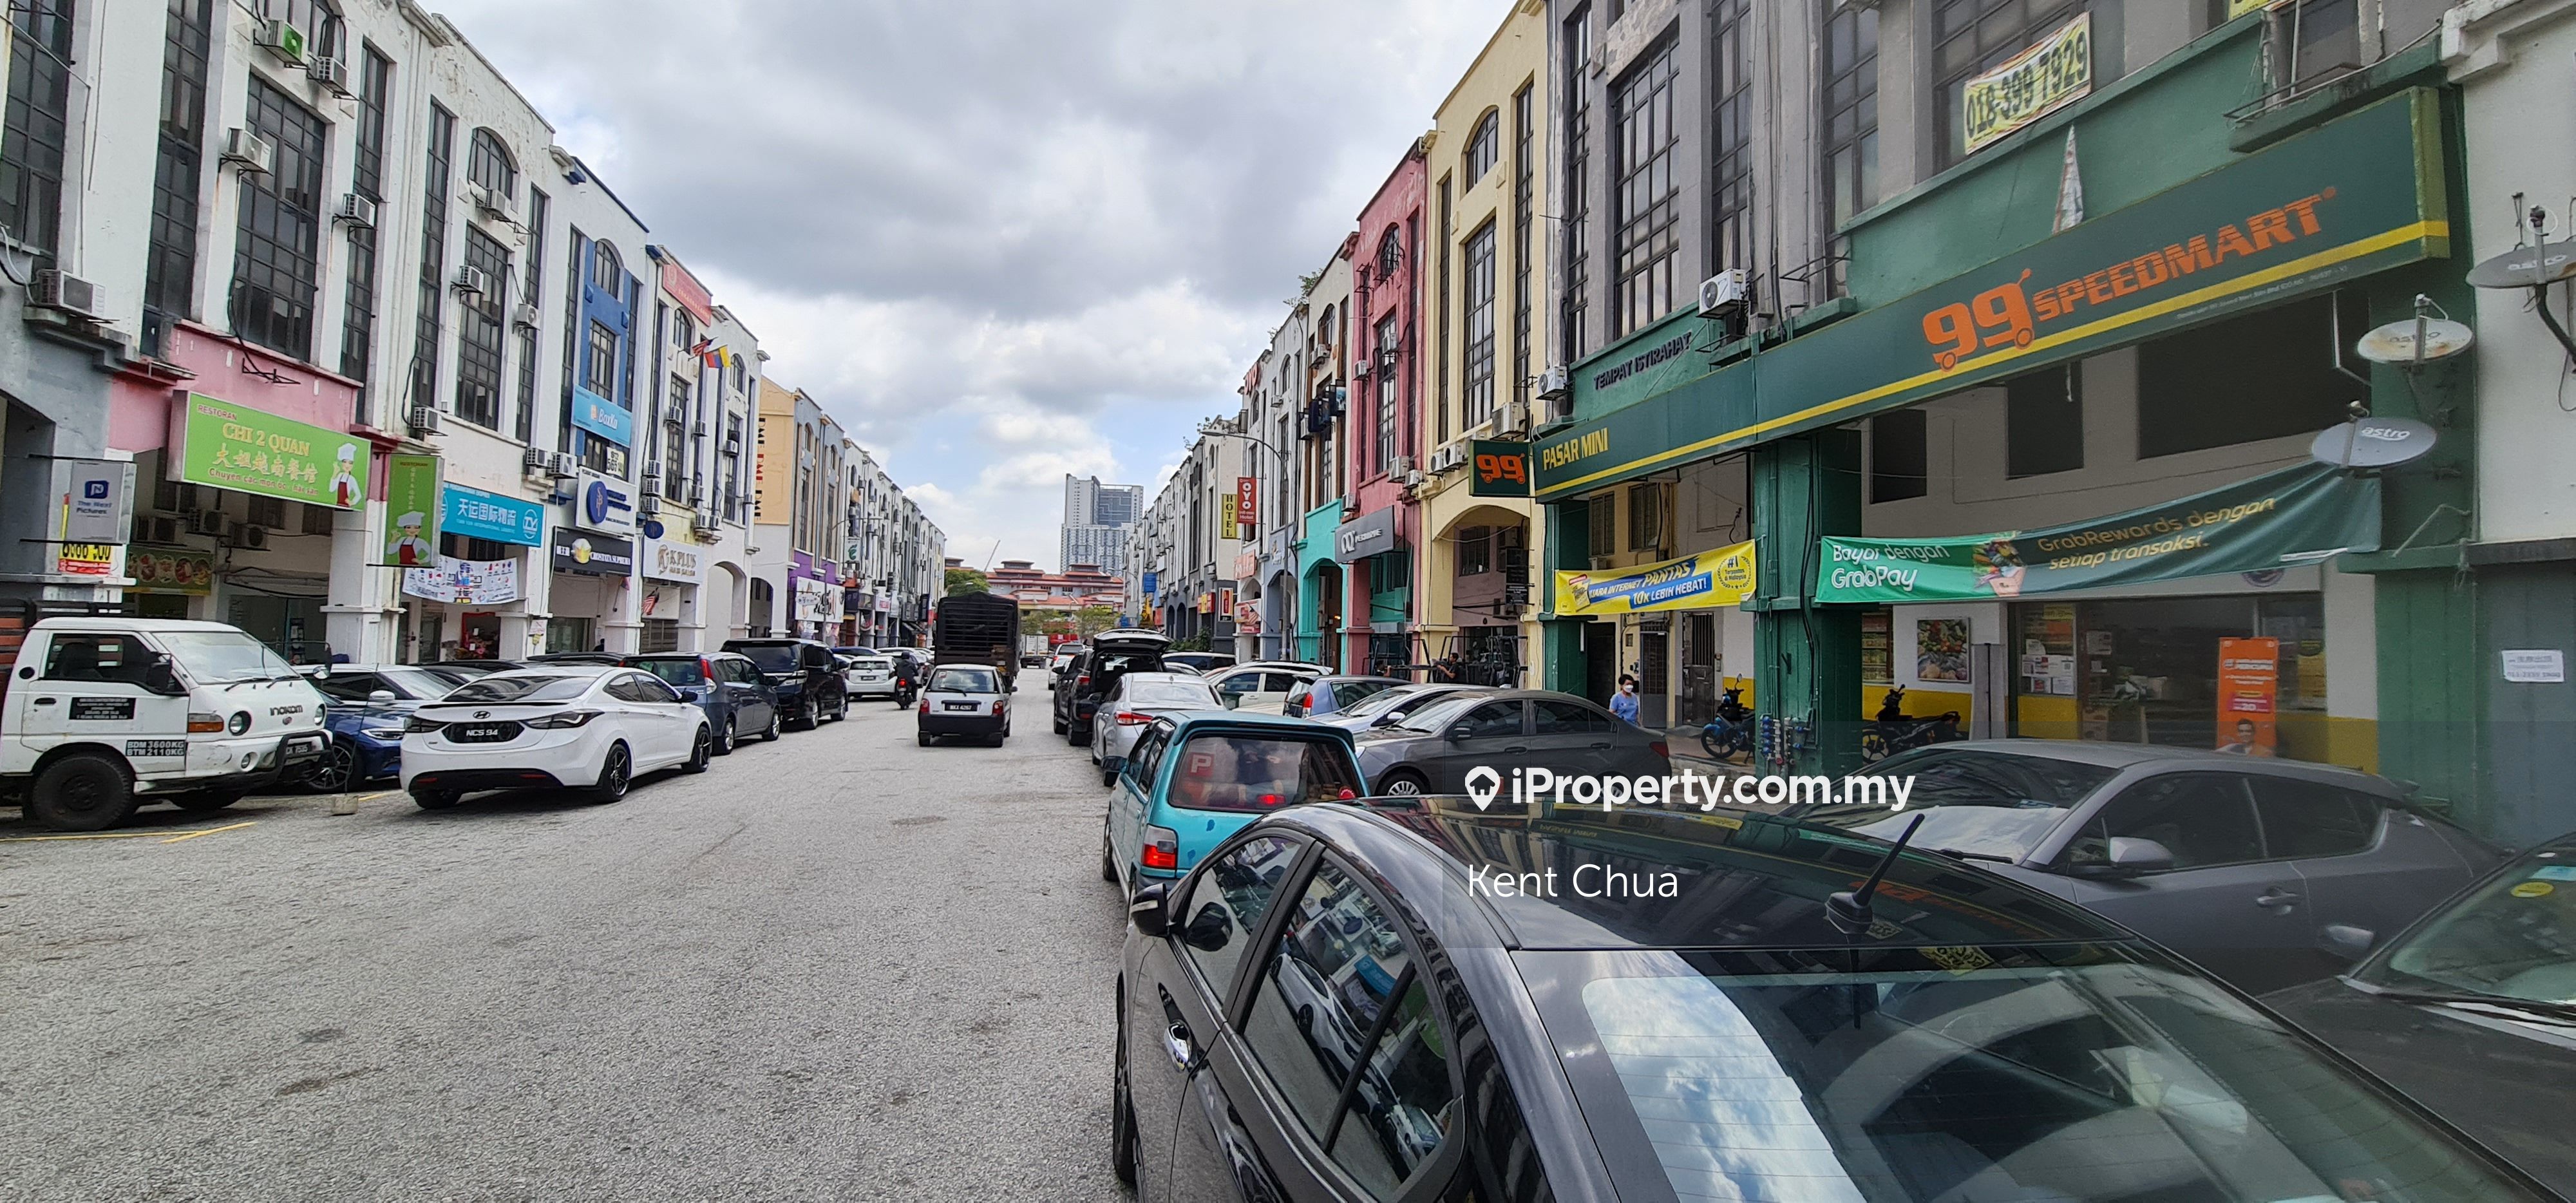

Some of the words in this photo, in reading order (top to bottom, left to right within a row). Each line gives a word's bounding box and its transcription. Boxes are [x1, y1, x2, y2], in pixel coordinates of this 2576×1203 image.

[1967, 63, 2034, 138] 018-399
[2039, 31, 2088, 100] 7929
[1922, 268, 2034, 372] 99
[2032, 193, 2322, 321] SPEEDMART
[1594, 359, 1633, 390] TEMPAT
[1634, 331, 1691, 374] ISTIRAHAT
[198, 404, 238, 421] RESTORAN
[222, 422, 253, 444] CHI
[256, 430, 265, 447] 2
[268, 433, 310, 456] QUAN
[2362, 425, 2410, 440] astro
[1542, 438, 1580, 471] PASAR
[1580, 427, 1609, 459] MINI
[1476, 453, 1526, 484] 99
[1242, 482, 1252, 510] OYO
[457, 498, 516, 527] 天运国际物流
[2038, 517, 2183, 552] GrabRewards
[2188, 498, 2275, 527] dengan
[1833, 545, 1879, 565] Bayar
[1884, 544, 1950, 562] dengan
[2049, 550, 2105, 570] setiap
[2110, 531, 2210, 562] transaksi.
[1607, 579, 1643, 594] INTERNET
[1642, 562, 1690, 587] PANTAS
[1651, 585, 1674, 601] LEBIH
[1675, 578, 1707, 595] HEBAT!
[1831, 565, 1918, 591] GrabPay
[1192, 755, 1212, 773] P
